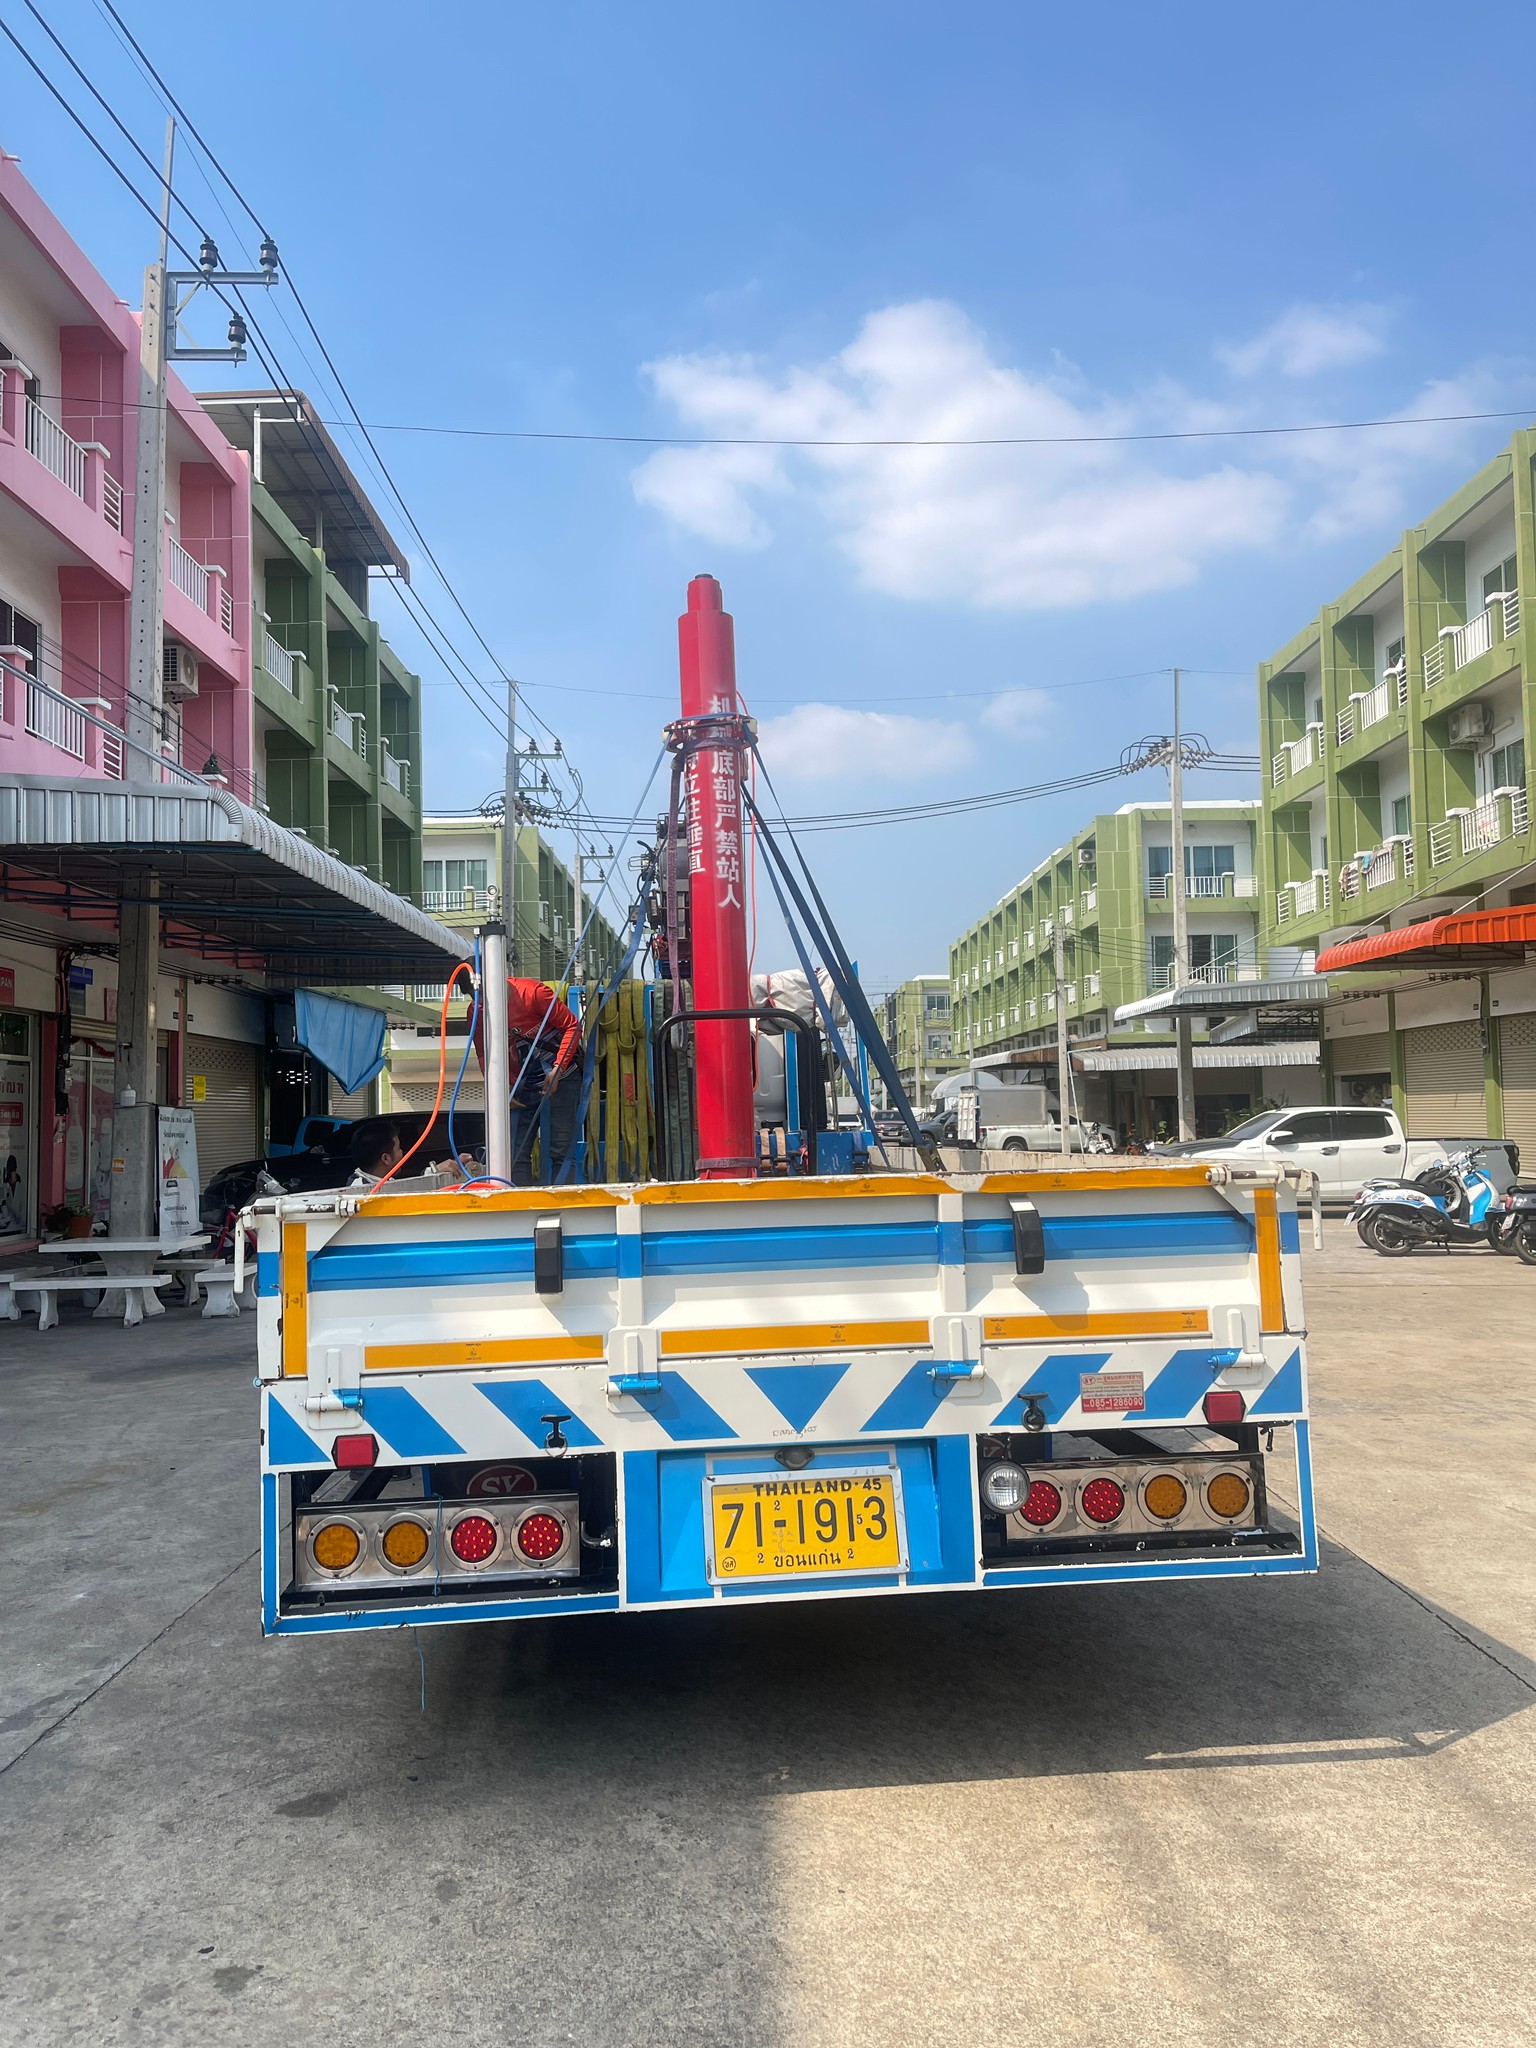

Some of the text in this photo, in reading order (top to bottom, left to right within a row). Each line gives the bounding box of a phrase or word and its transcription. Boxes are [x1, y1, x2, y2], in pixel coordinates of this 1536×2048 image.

[721, 1495, 887, 1549] 71-1913
[774, 1549, 841, 1568] ขอนแก่น
